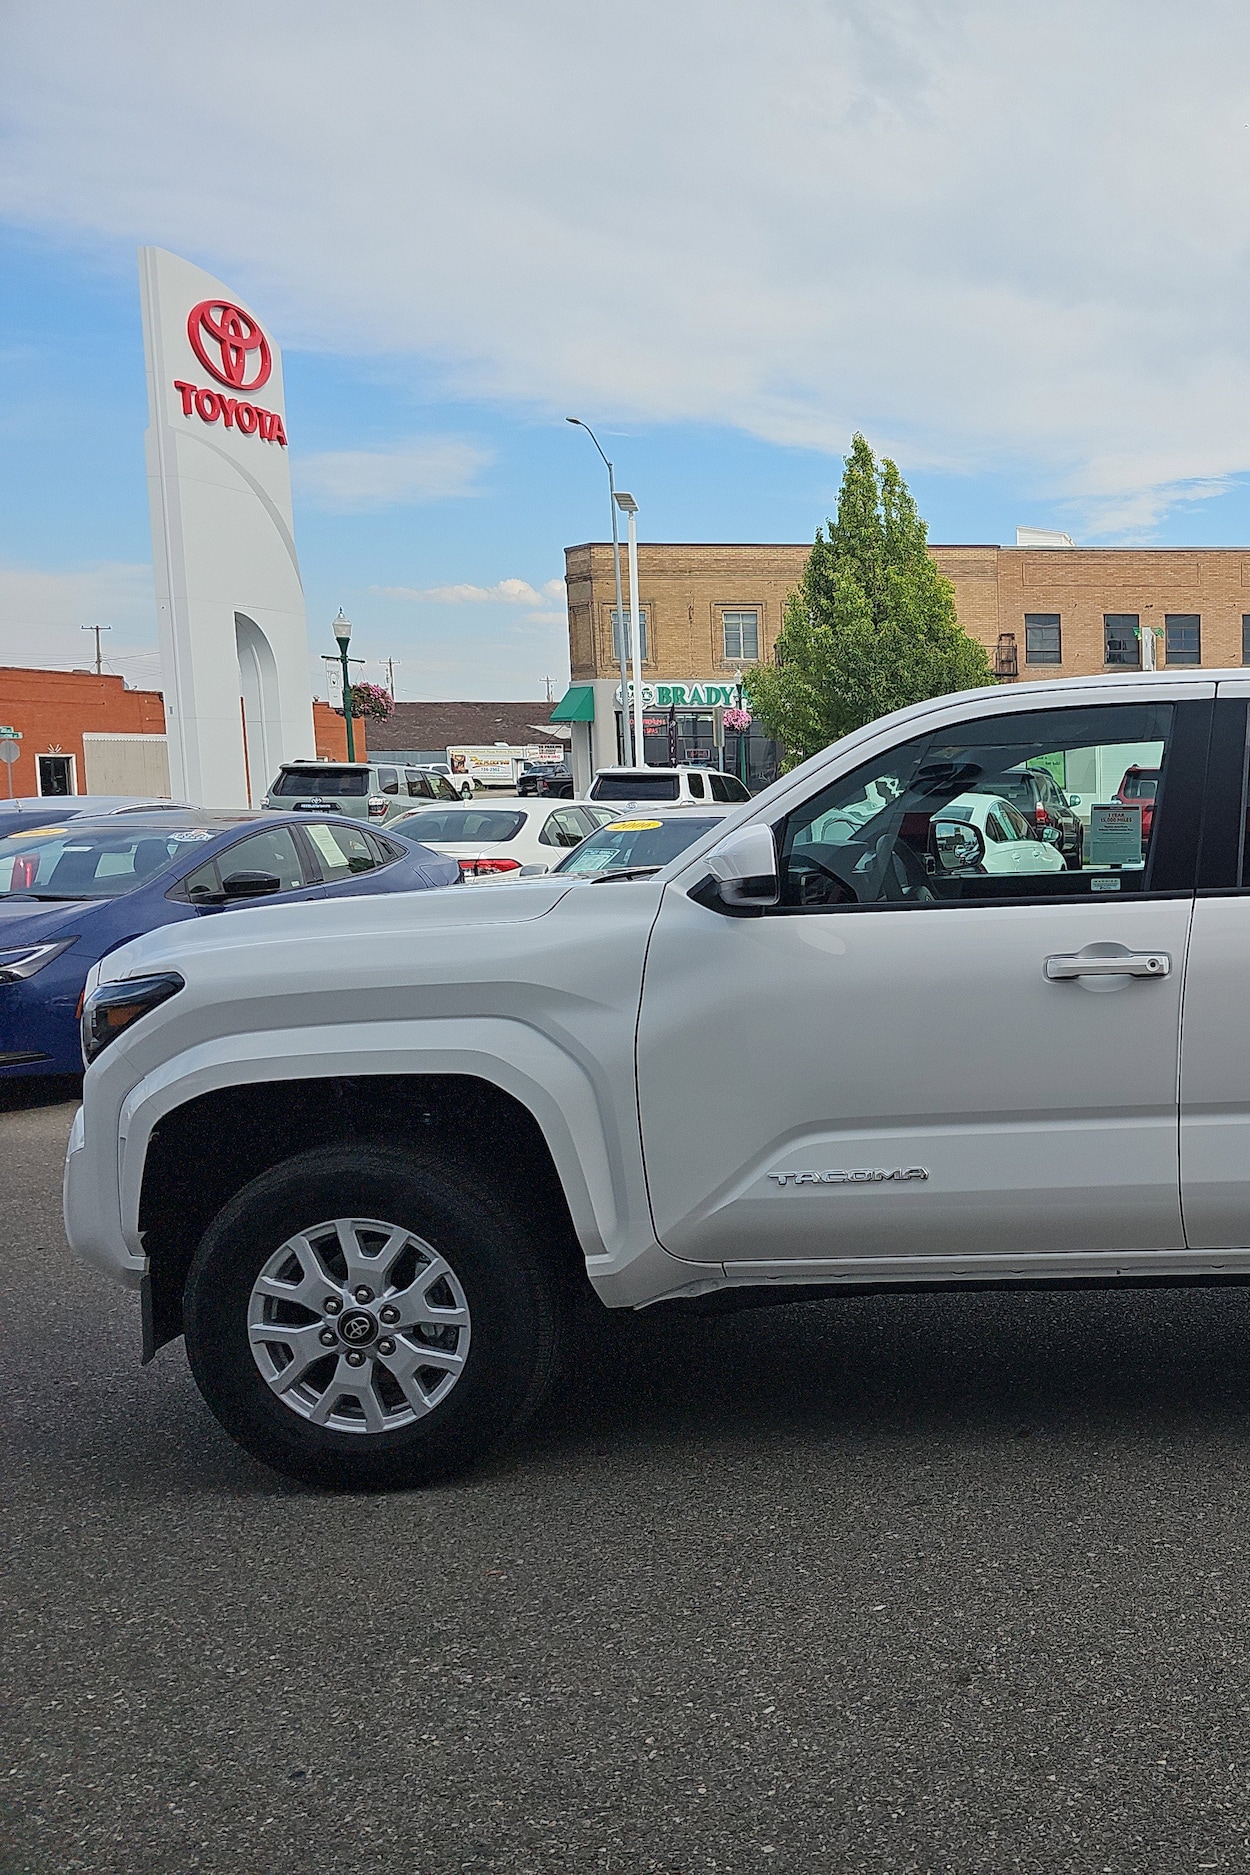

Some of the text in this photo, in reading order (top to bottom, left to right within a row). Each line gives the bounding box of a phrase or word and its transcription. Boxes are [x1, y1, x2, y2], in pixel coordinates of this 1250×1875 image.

[174, 380, 287, 446] TOYOTA
[657, 686, 753, 706] BRADY
[768, 1166, 929, 1185] TACOMA
